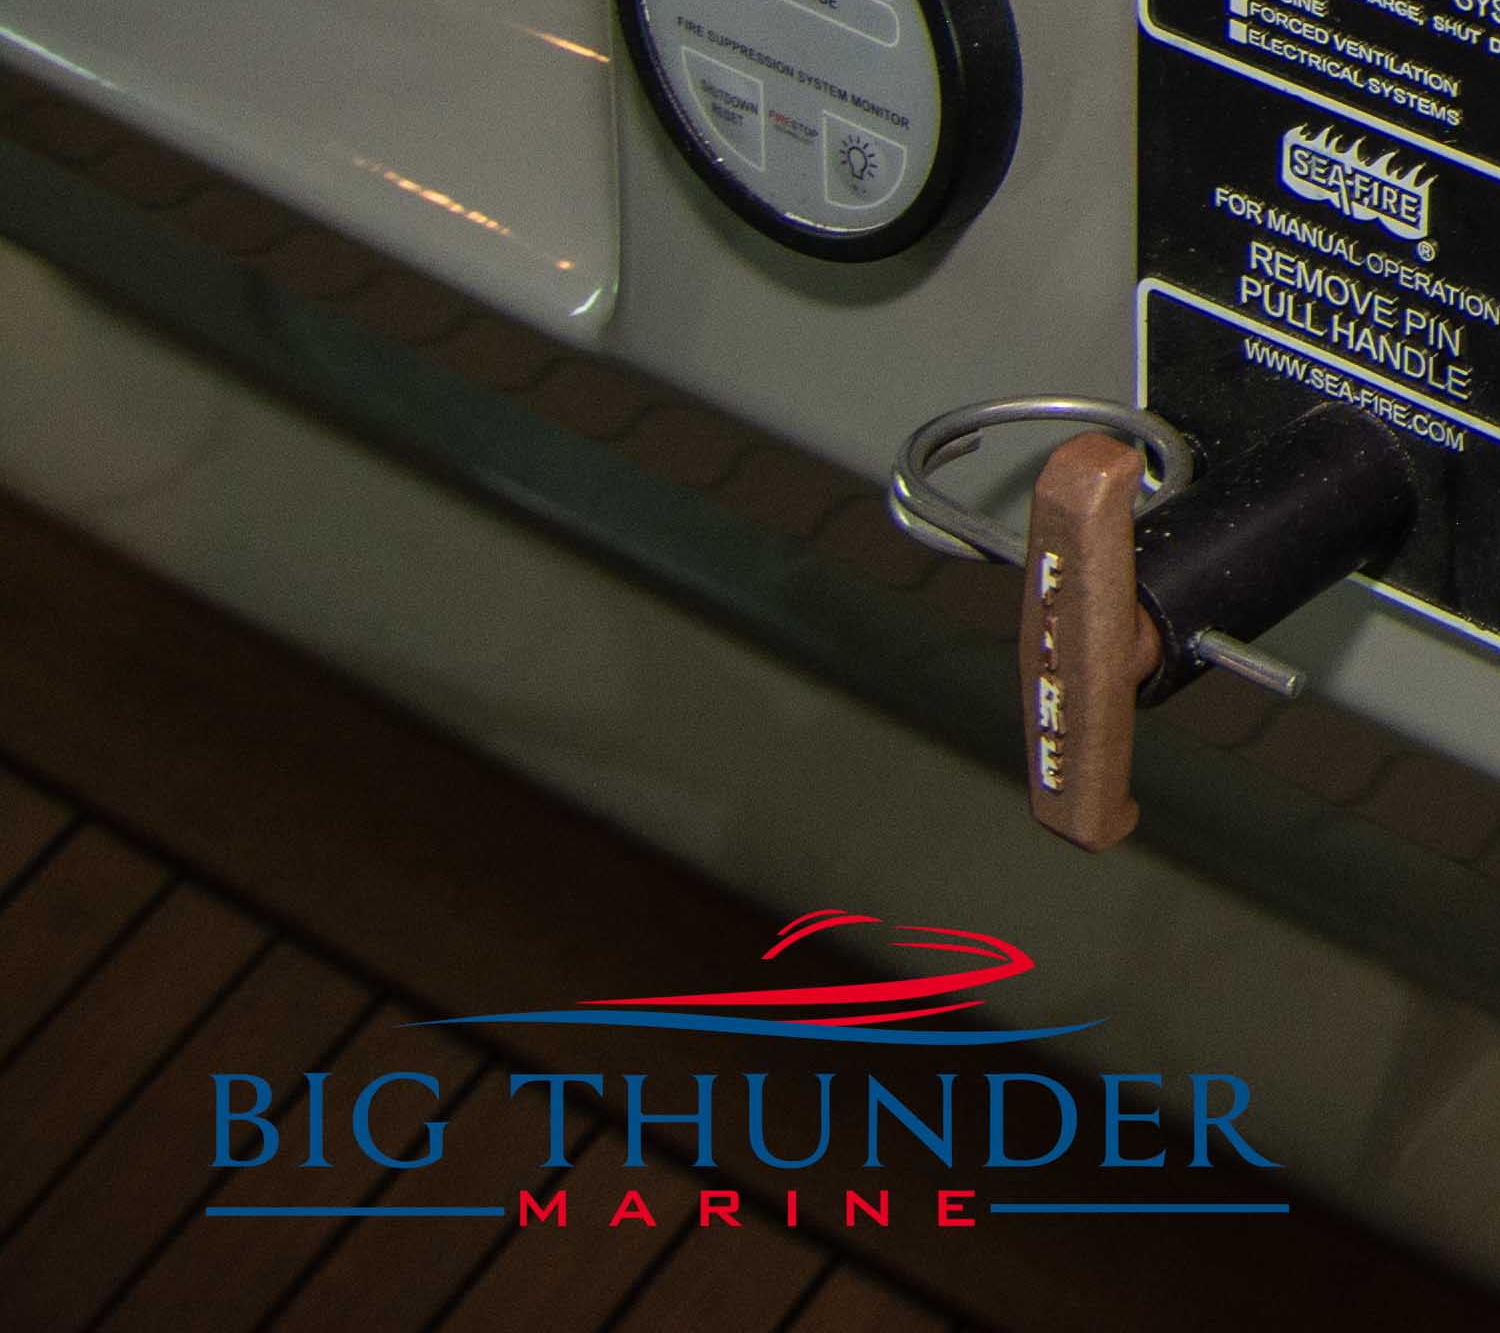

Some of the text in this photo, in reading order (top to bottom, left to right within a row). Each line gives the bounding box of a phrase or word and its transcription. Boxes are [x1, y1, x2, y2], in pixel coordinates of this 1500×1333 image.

[707, 29, 795, 78] SUPPRESSION
[798, 69, 848, 103] SYSTEM
[851, 93, 910, 130] MONITOR
[1248, 26, 1459, 128] ELECTRICAL SYSTEMS
[1250, 1, 1458, 99] FORCED VENTILATION
[1432, 13, 1479, 46] SHUT
[1292, 148, 1419, 224] SEA-FIRE
[1215, 186, 1500, 327] FOR MANUAL OPERATION
[1250, 239, 1461, 359] REMOVE PIN
[1241, 274, 1471, 402] PULL HANDLE
[1243, 338, 1465, 452] WWW.SEA-FIRE.COM
